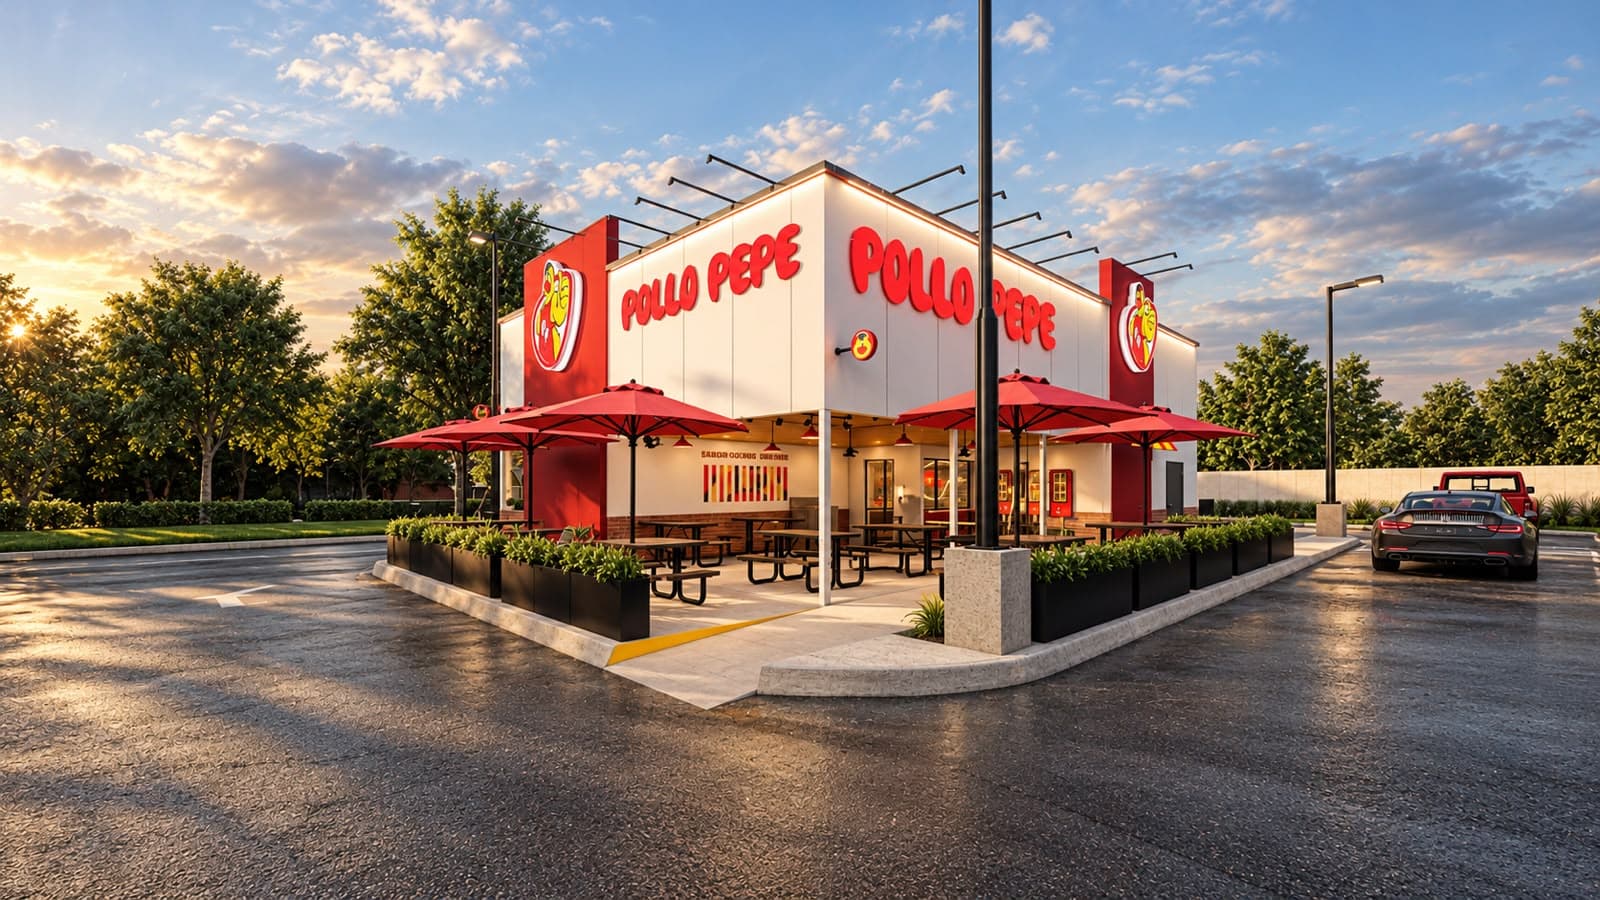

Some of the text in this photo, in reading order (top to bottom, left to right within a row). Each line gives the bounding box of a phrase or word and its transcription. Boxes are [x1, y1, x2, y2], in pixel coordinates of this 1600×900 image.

[621, 223, 802, 331] POLLO PEPE
[849, 225, 975, 325] POLLO
